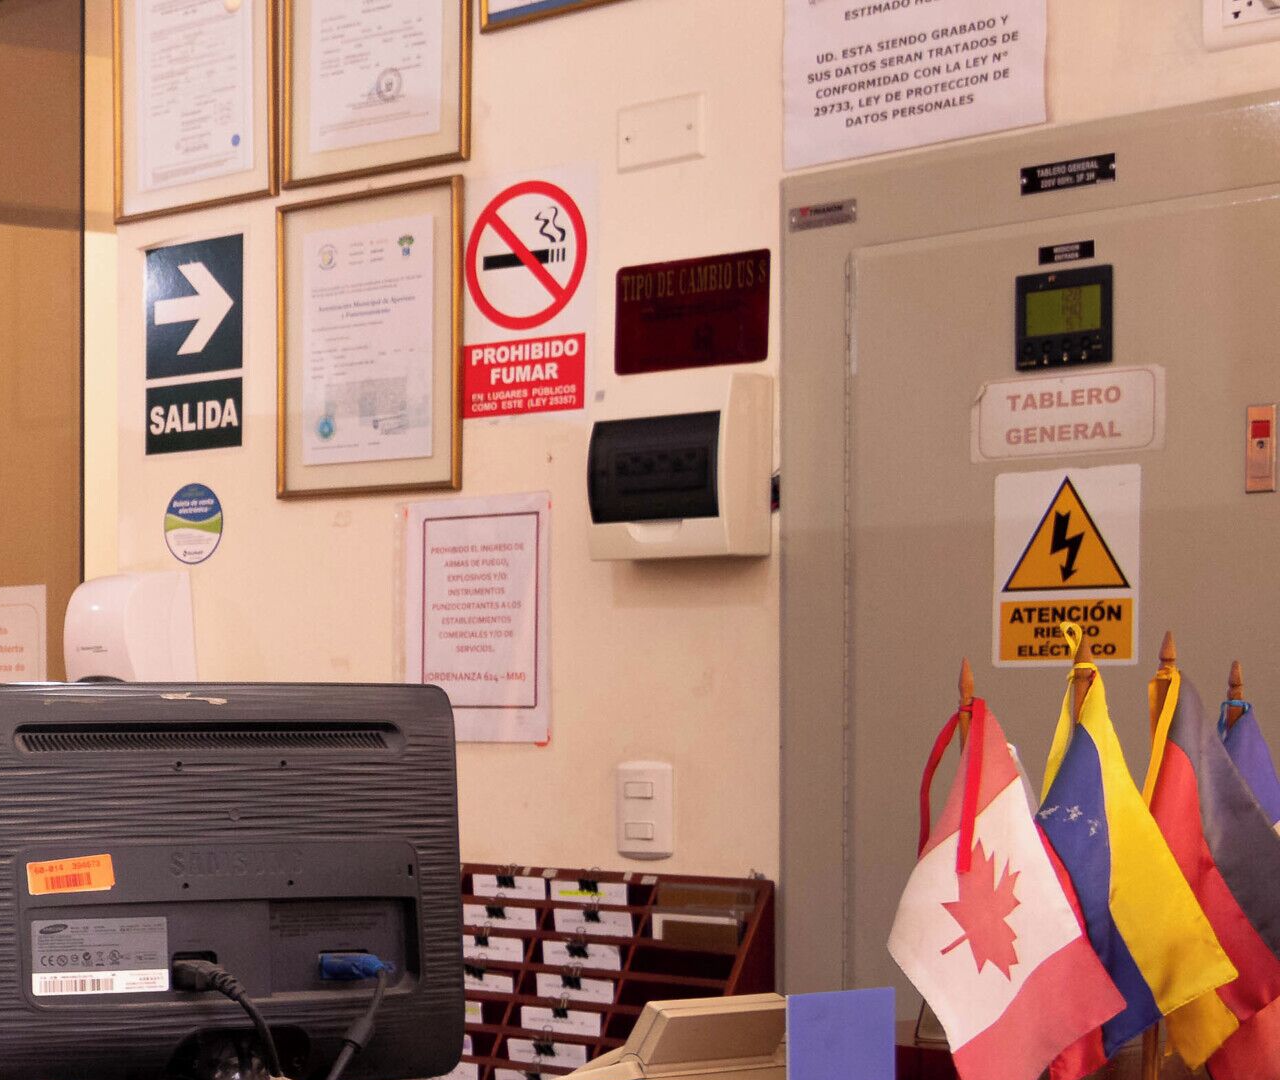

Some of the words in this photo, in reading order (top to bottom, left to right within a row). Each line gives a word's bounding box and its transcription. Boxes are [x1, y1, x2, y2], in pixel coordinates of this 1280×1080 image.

[844, 0, 910, 21] ESTIMADO
[816, 52, 837, 65] UD.
[841, 44, 873, 60] ESTA
[877, 33, 927, 52] SIENDO
[931, 19, 996, 40] GRABADO
[1000, 14, 1009, 25] Y
[807, 70, 831, 84] SUS
[835, 60, 876, 79] DATOS
[880, 51, 923, 70] SERAN
[927, 36, 997, 60] TRATADOS
[1001, 30, 1019, 44] DE
[815, 71, 909, 99] CONFORMIDAD
[913, 65, 941, 80] CON
[945, 61, 961, 73] LA
[965, 54, 988, 70] LEY
[858, 94, 880, 109] LEY
[885, 90, 902, 102] DE
[906, 73, 989, 99] PROTECCION
[993, 68, 1010, 81] DE
[845, 111, 887, 128] DATOS
[892, 93, 975, 119] PERSONALES
[622, 273, 652, 302] TIPO
[658, 271, 674, 298] DE
[680, 262, 732, 294] CAMBIO
[738, 260, 754, 287] US
[471, 338, 578, 366] PROHIBIDO
[490, 362, 558, 385] FUMAR
[472, 393, 484, 403] EN
[488, 389, 528, 401] LUGARES
[472, 402, 497, 413] COMO
[502, 399, 523, 410] ESTE
[528, 397, 547, 409] (LEY
[1006, 385, 1122, 412] TABLERO
[150, 398, 239, 436] SALIDA
[1005, 420, 1122, 446] GENERAL
[430, 545, 469, 555] PROHIBIDO
[471, 545, 479, 553] EL
[480, 543, 513, 553] INGRESO
[514, 542, 524, 551] DE
[444, 560, 470, 568] ARMAS
[471, 559, 480, 567] DE
[447, 574, 491, 583] EXPLOSIVOS
[448, 587, 505, 597] INSTRUMENTOS
[432, 602, 499, 611] PUNZOCORTANTES
[508, 601, 522, 609] LOS
[1010, 600, 1122, 624] ATENCIÓN
[441, 616, 512, 625] ESTABLECIMIENTOS
[439, 631, 488, 639] COMERCIALES
[1034, 625, 1100, 639] RIEO
[1017, 641, 1117, 657] ELÉCTCO
